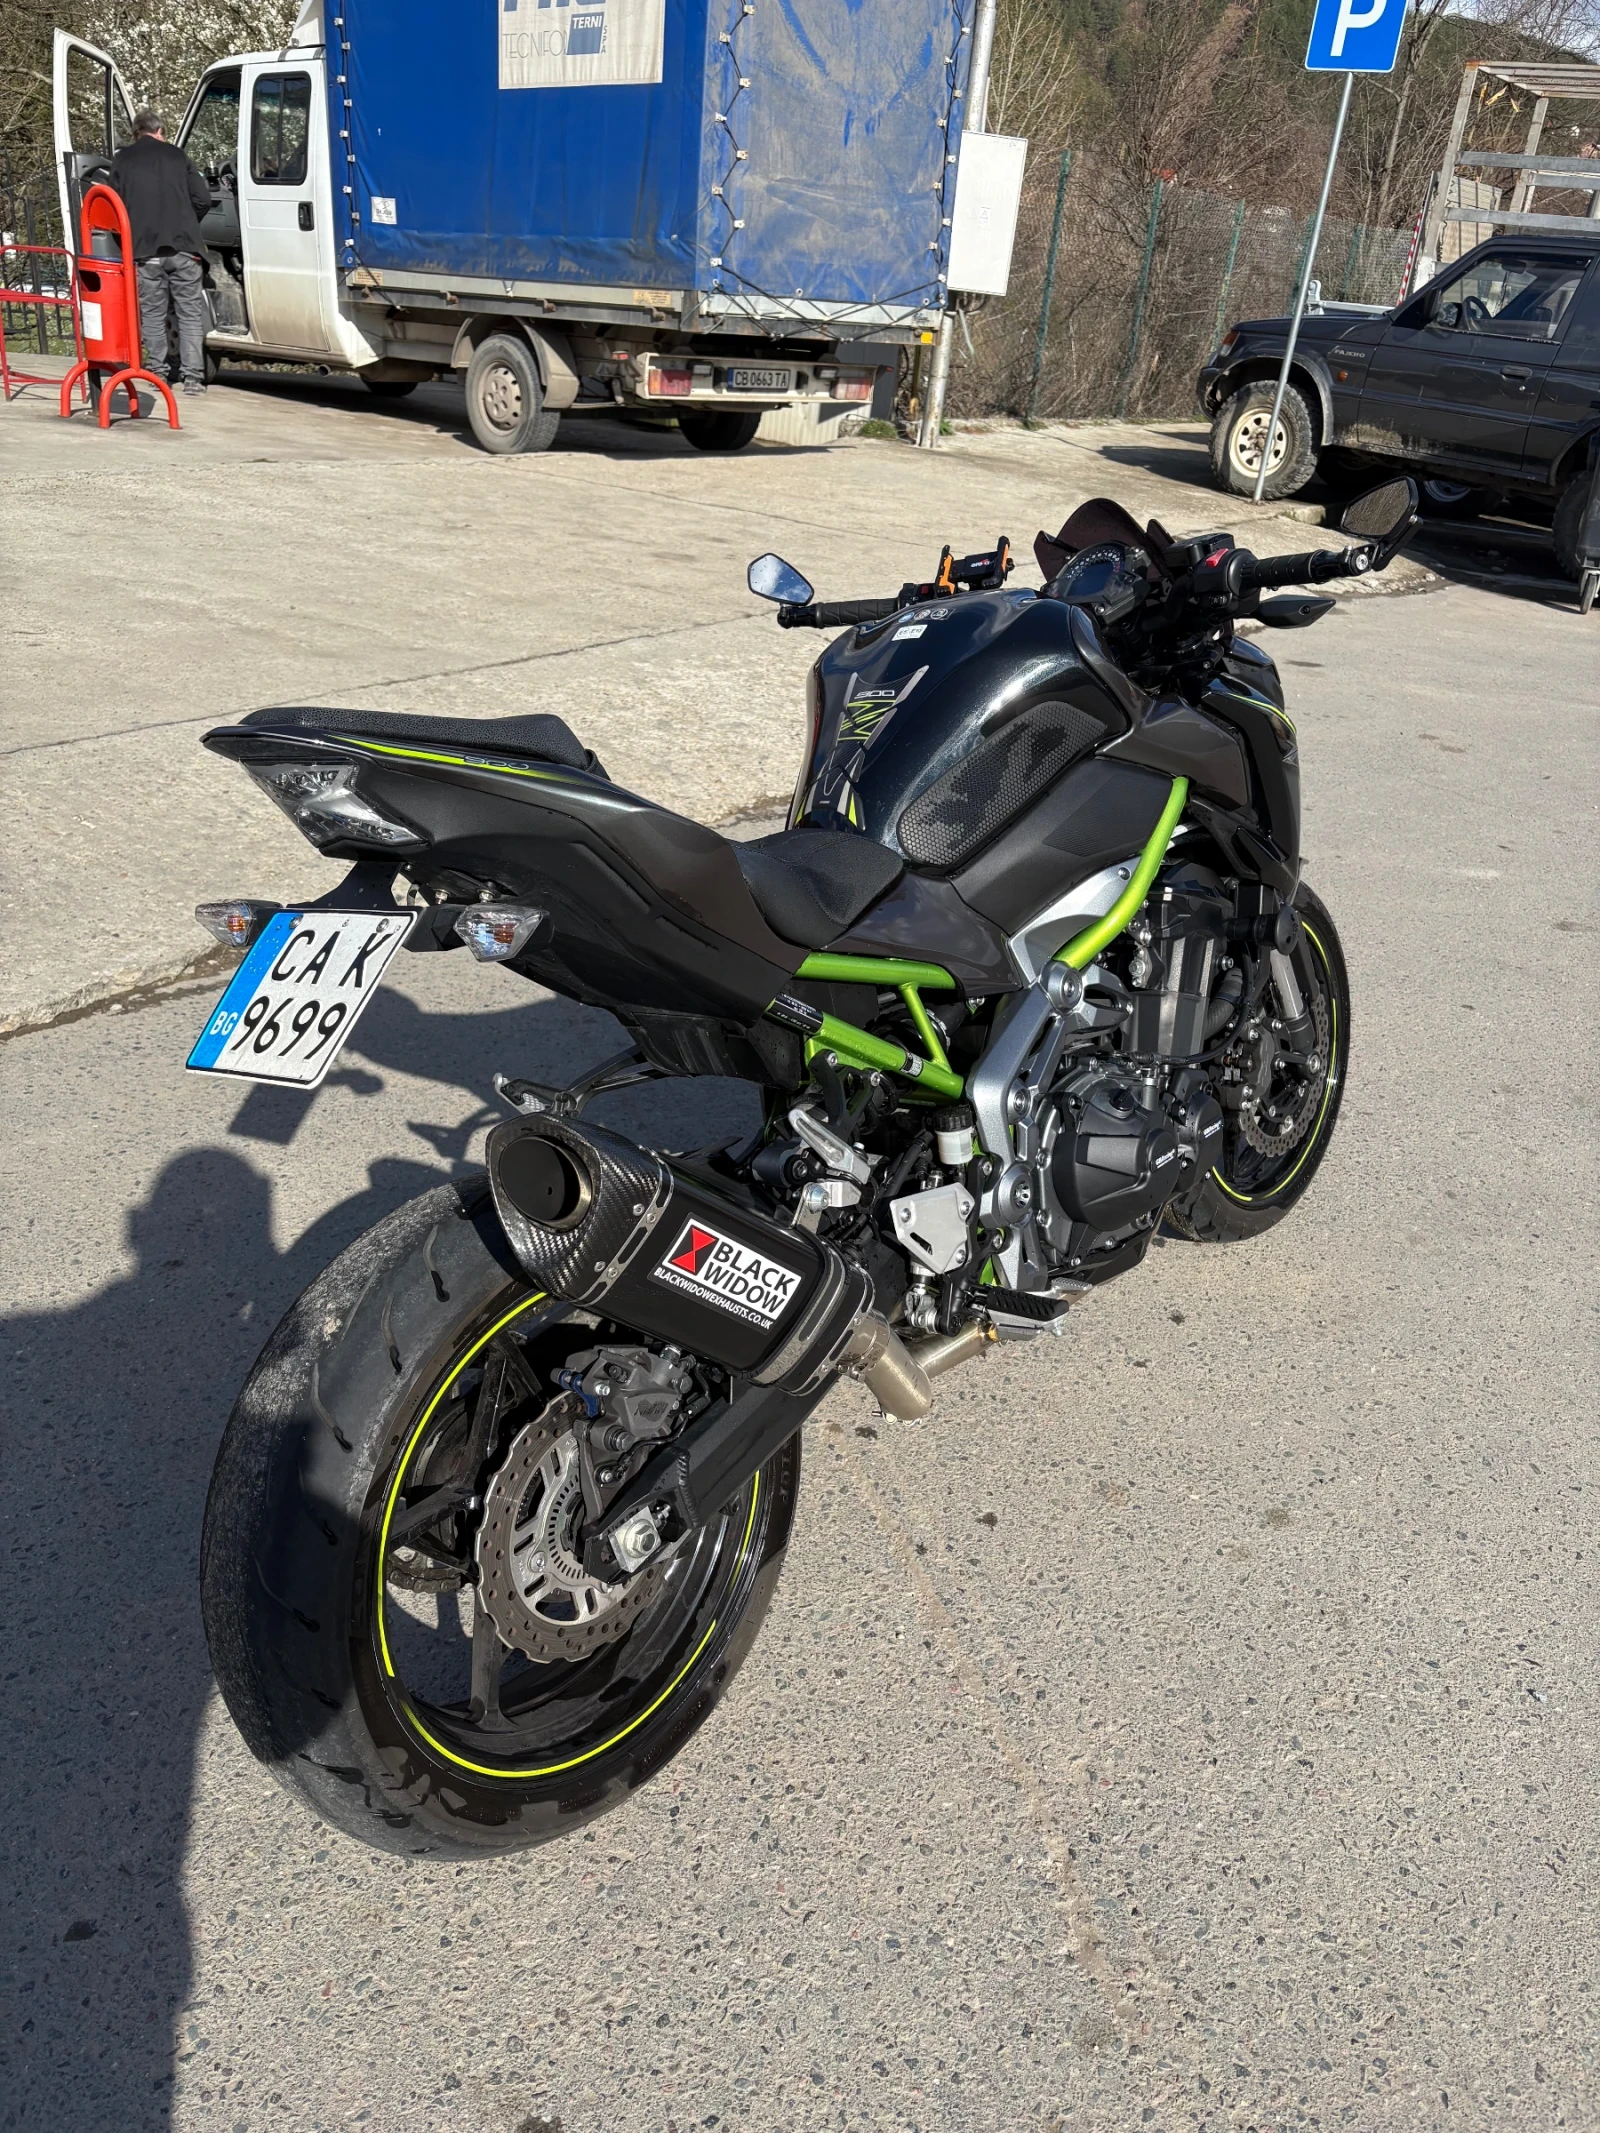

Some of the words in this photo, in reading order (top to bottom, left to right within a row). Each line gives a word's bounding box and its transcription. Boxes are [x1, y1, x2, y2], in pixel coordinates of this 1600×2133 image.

[572, 15, 603, 29] TERNI
[1330, 0, 1387, 56] P
[1334, 349, 1366, 358] PAJERO
[750, 371, 773, 386] 0663
[775, 372, 787, 387] TA
[854, 690, 895, 699] 900
[464, 755, 529, 770] 900
[271, 929, 341, 985] CA
[338, 932, 395, 989] K
[209, 1011, 239, 1036] BG
[230, 995, 348, 1060] 9699
[703, 1262, 785, 1314] WIDOW
[713, 1241, 796, 1297] BLACK
[653, 1266, 774, 1330] BLACKWIDOWEXHAUSTS.CO.UK
